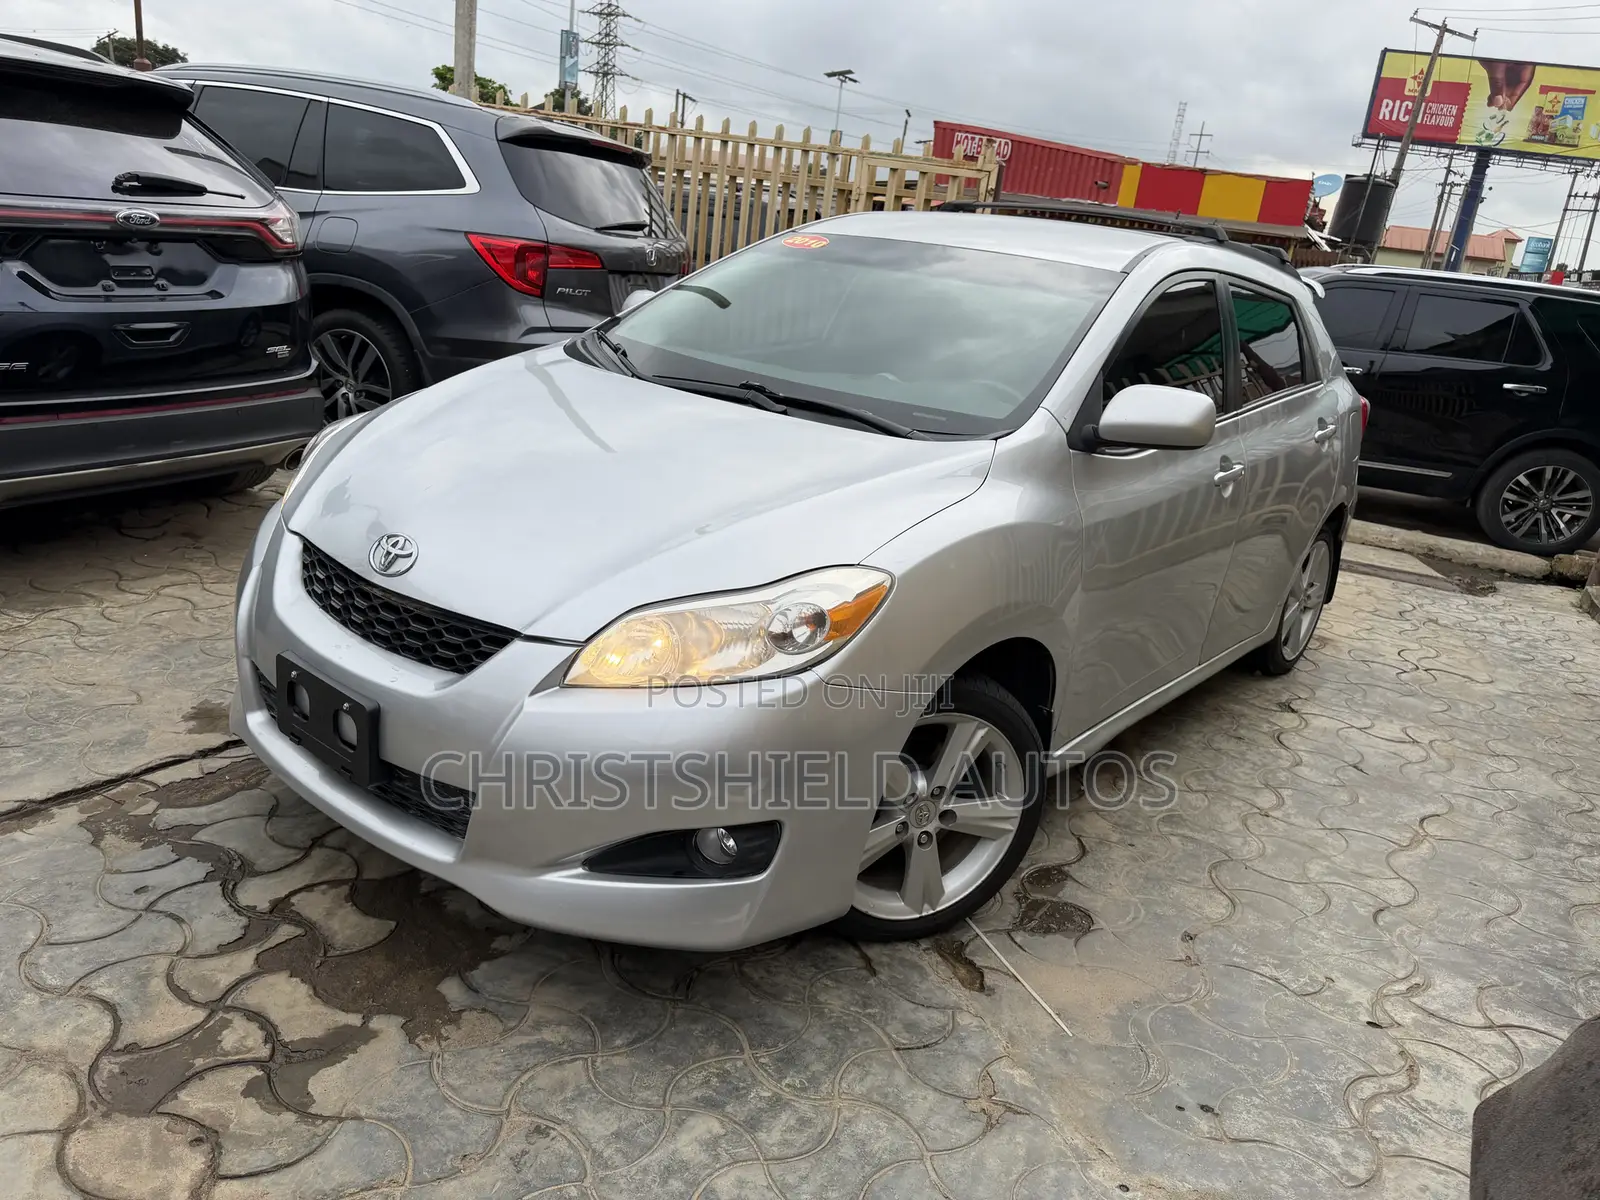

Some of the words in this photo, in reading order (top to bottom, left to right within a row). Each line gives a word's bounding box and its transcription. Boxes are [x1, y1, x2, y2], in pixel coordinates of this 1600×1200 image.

[1426, 102, 1458, 117] CHICKEN
[1423, 113, 1455, 128] FLAVOUR
[975, 136, 1012, 161] BAD
[130, 213, 152, 225] Ford
[556, 287, 591, 296] PILOT
